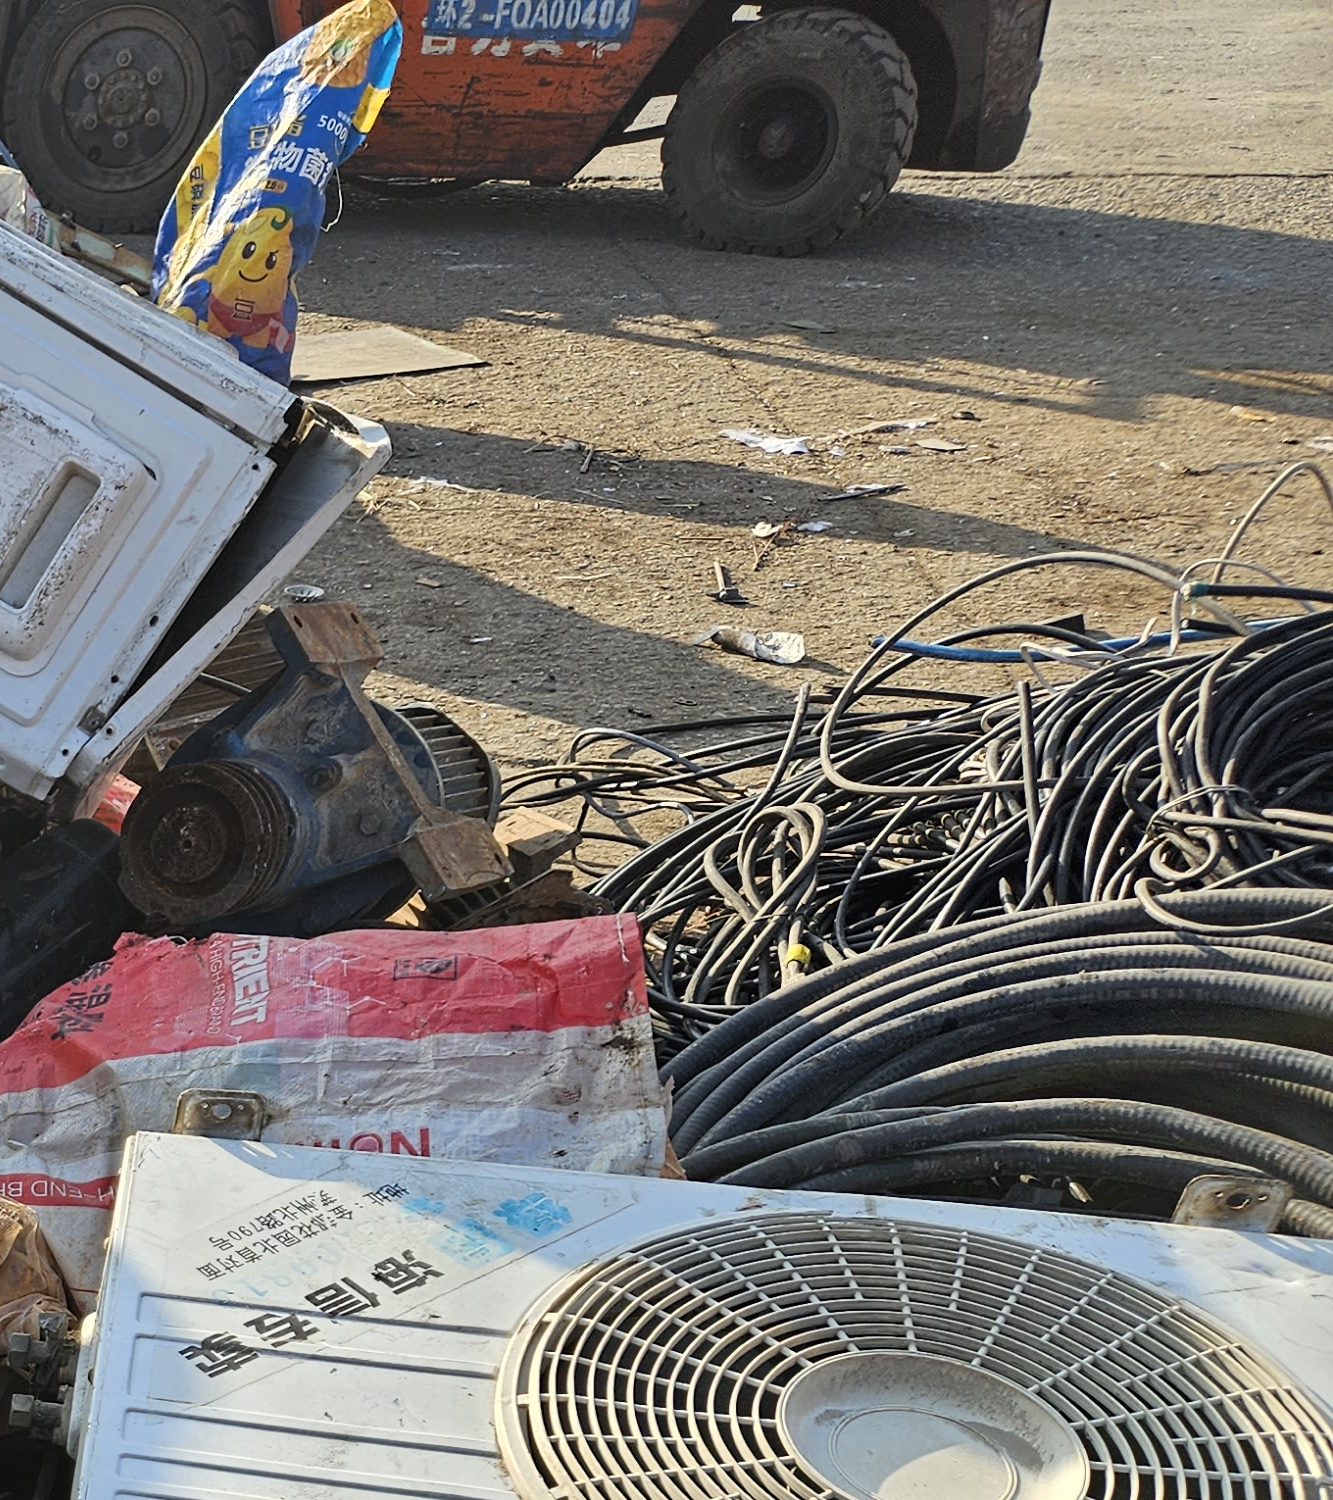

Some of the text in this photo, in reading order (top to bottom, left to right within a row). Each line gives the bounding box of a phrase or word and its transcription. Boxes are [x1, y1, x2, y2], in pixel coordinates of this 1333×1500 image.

[317, 115, 349, 145] 5000
[177, 1248, 443, 1378] 海信专卖
